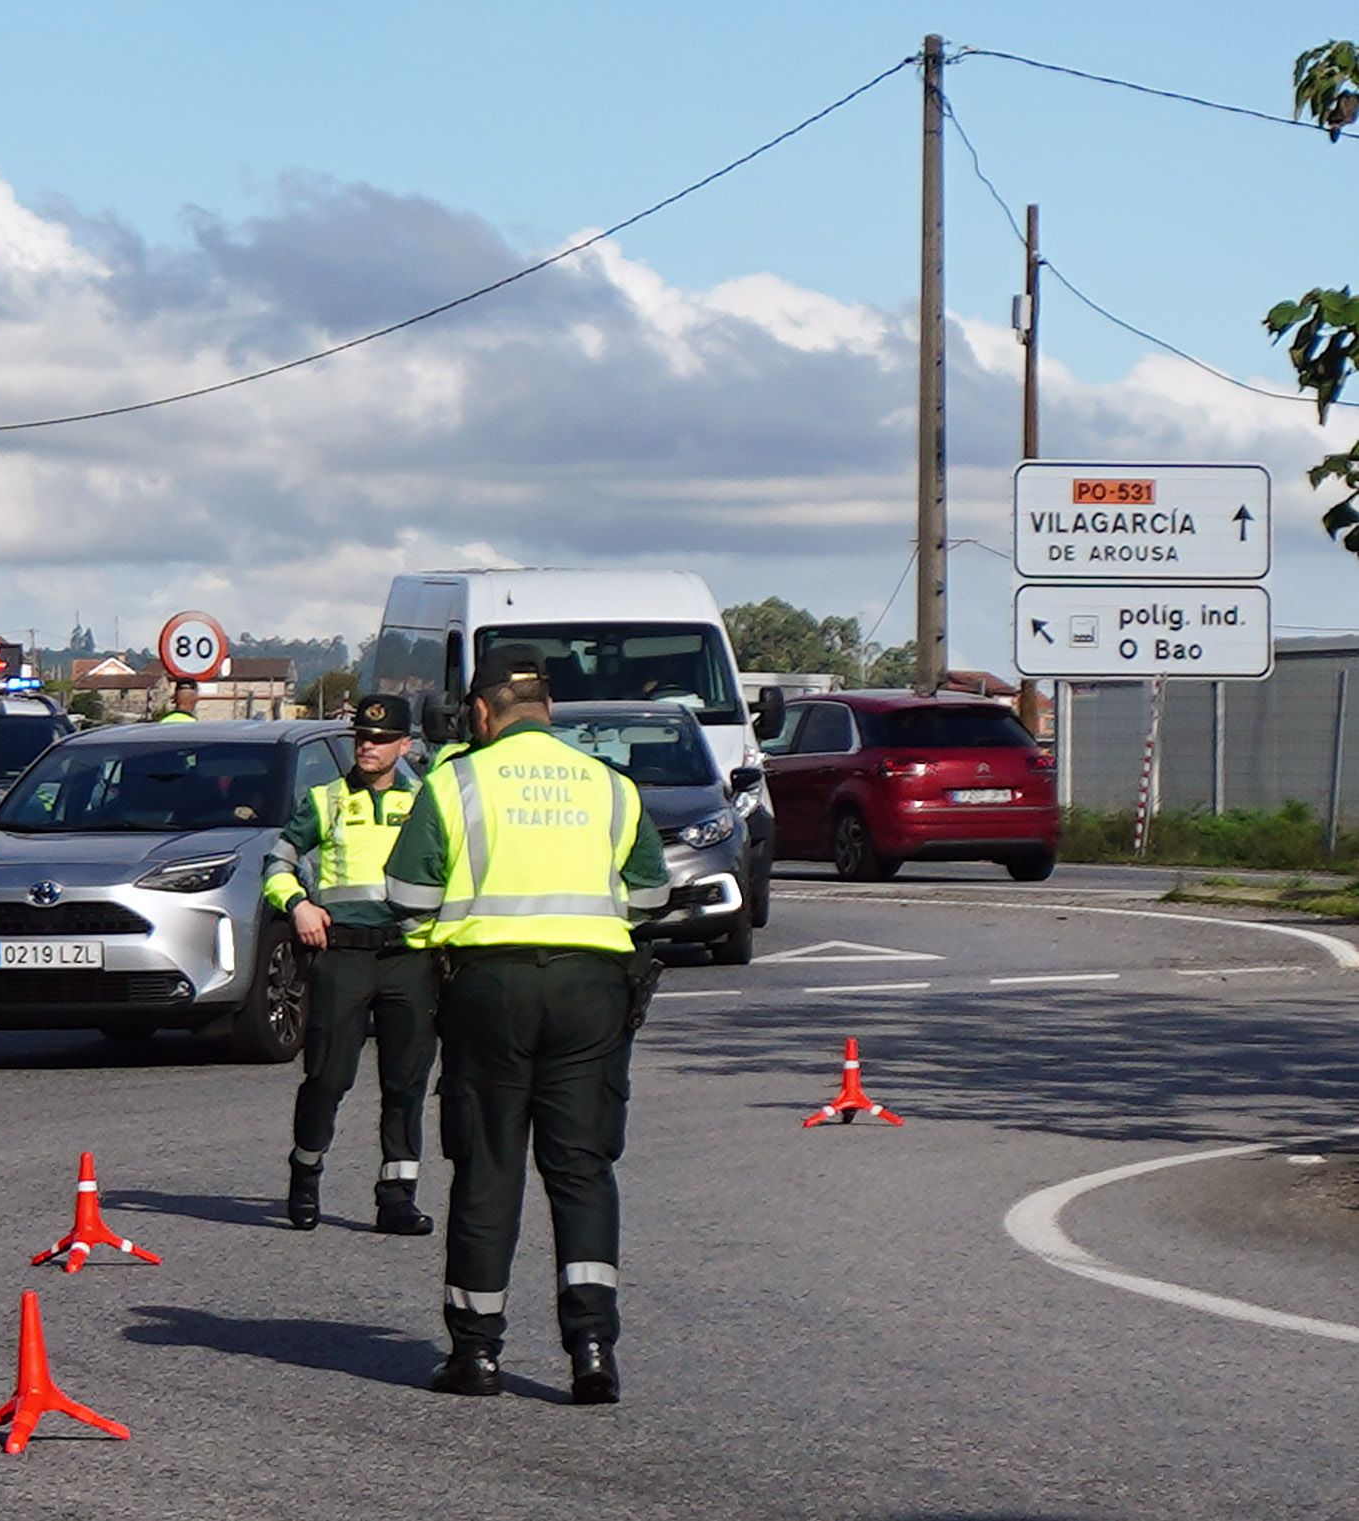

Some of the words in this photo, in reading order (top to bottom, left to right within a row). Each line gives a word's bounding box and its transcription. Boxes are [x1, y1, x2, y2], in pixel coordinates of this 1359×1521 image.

[1077, 483, 1153, 501] PO-531
[1031, 507, 1196, 535] VILAGARCÍA
[1049, 545, 1075, 561] DE
[1089, 545, 1179, 562] AROUSA
[1201, 605, 1246, 626] ind.
[176, 635, 213, 659] 80
[1119, 638, 1138, 659] O
[1155, 639, 1203, 660] Bao
[498, 764, 592, 782] GUARDIA
[522, 785, 572, 803] CIVIL
[506, 807, 589, 826] TRAFICO
[4, 945, 53, 963] 0219
[60, 945, 96, 963] LZL
